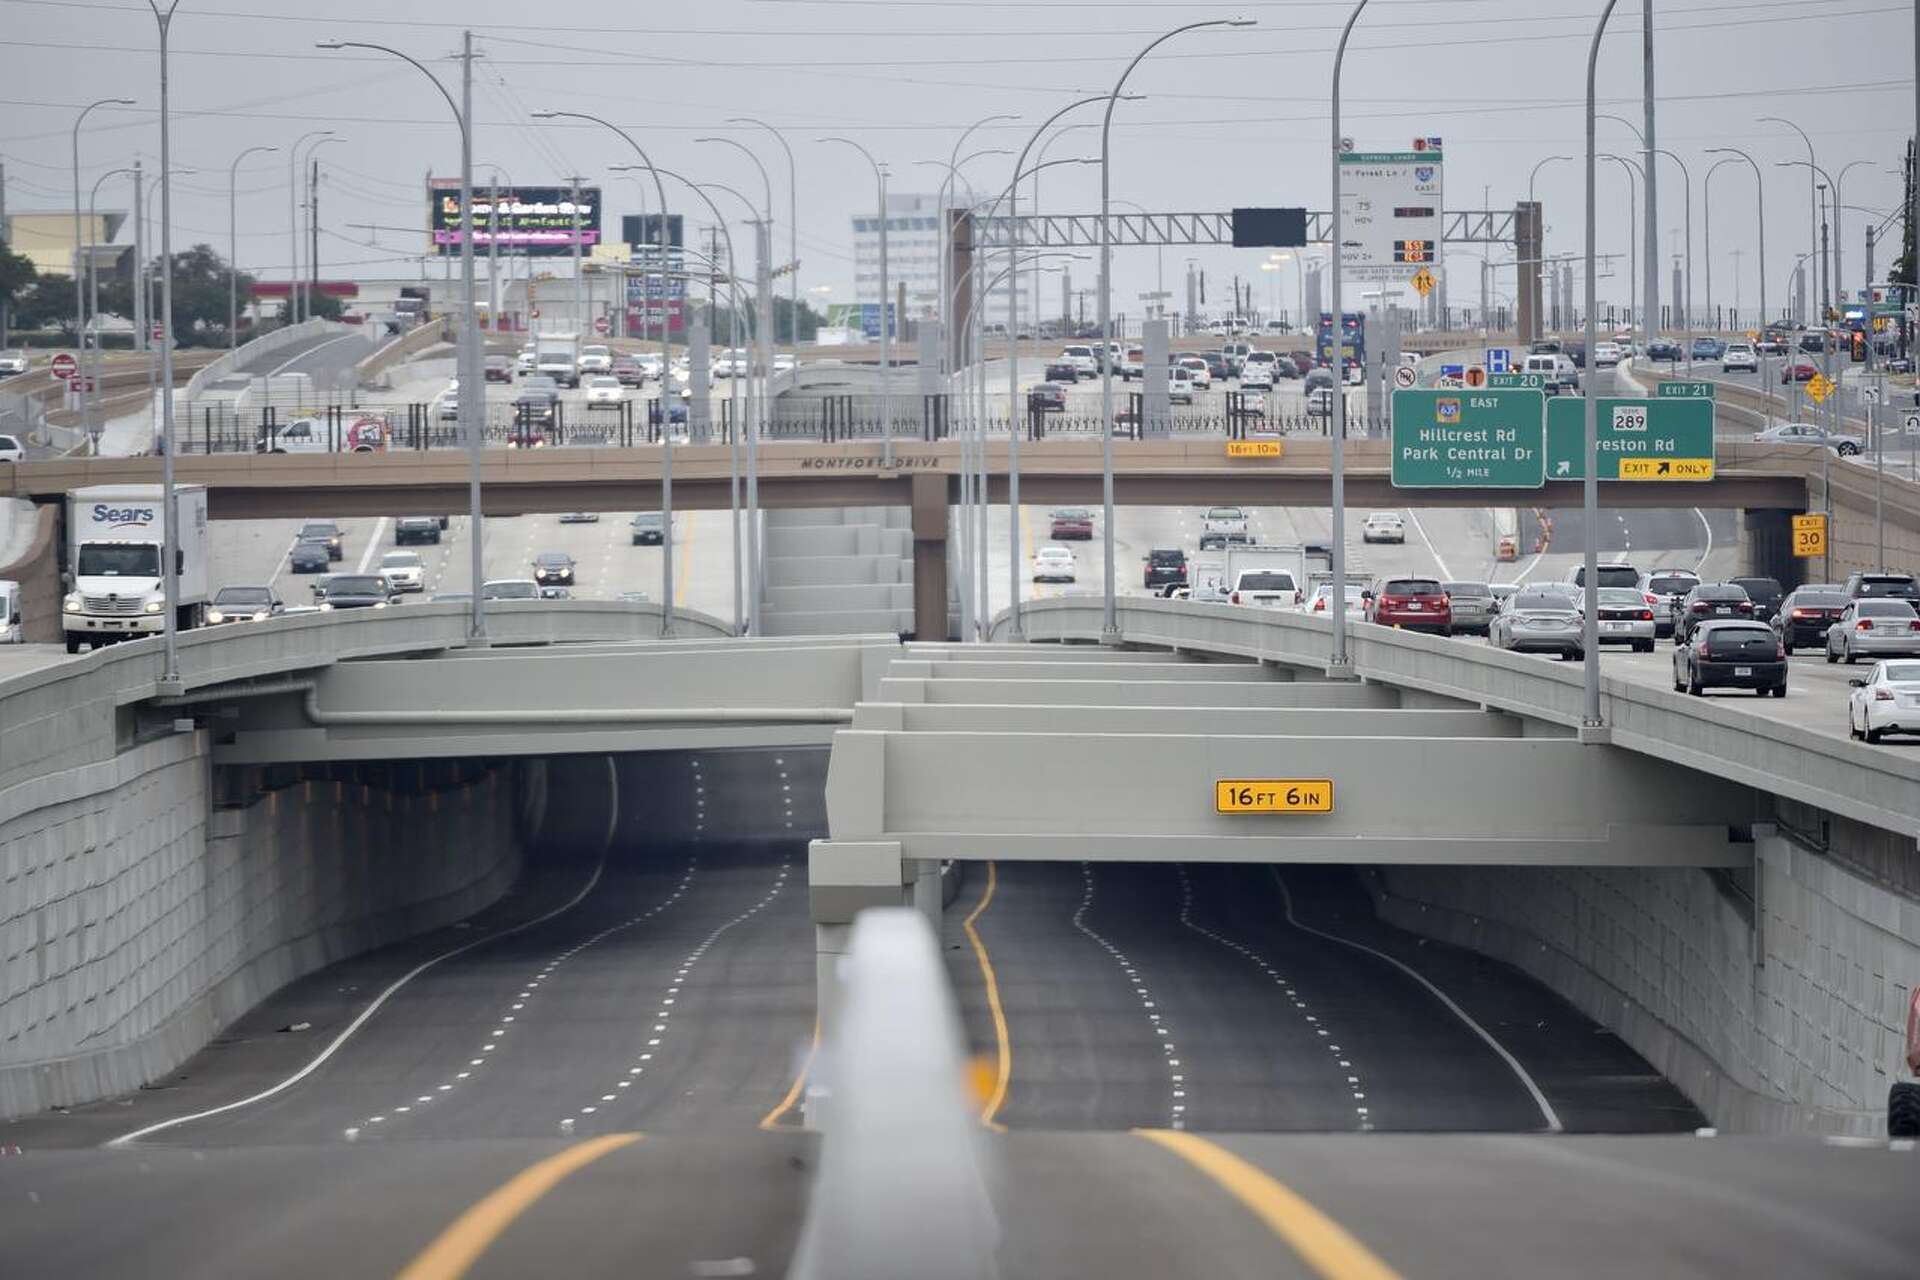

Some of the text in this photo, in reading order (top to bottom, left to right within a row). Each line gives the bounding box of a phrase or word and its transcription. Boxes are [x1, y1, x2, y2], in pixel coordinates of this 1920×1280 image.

[1493, 375, 1538, 387] EXIT 20
[1665, 385, 1707, 396] EXIT 21
[1470, 397, 1499, 409] EAST
[1615, 415, 1645, 429] 289
[1419, 428, 1516, 442] Hillcrest Rd
[1595, 439, 1675, 452] reston Rd
[1403, 447, 1534, 461] Park Central Dr
[895, 457, 940, 469] DRIVE
[1624, 463, 1708, 474] EXIT ONLY
[1467, 468, 1490, 477] MILE
[91, 504, 154, 523] Sears
[1799, 519, 1818, 527] EXIT
[1799, 532, 1820, 545] 30
